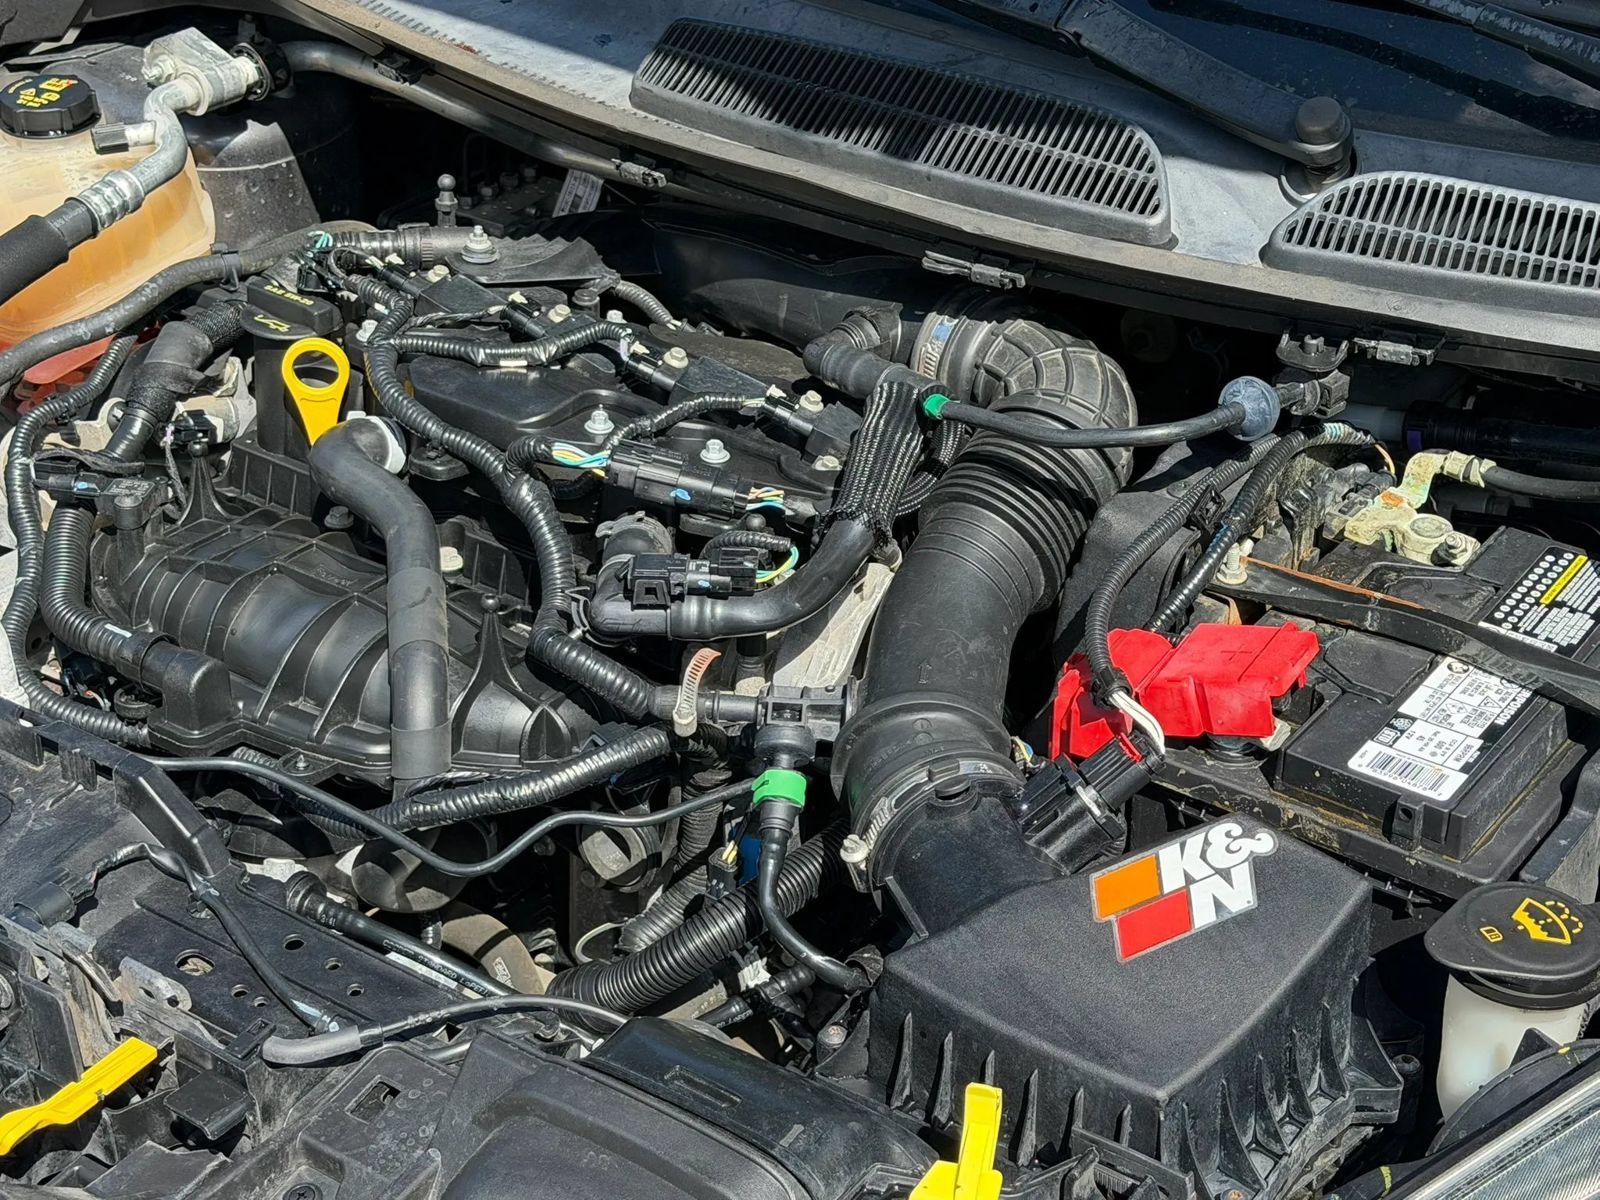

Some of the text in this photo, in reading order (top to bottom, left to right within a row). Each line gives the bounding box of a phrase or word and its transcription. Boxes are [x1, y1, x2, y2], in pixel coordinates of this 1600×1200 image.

[264, 285, 314, 305] SAE 5W-20
[1159, 823, 1273, 928] K&N
